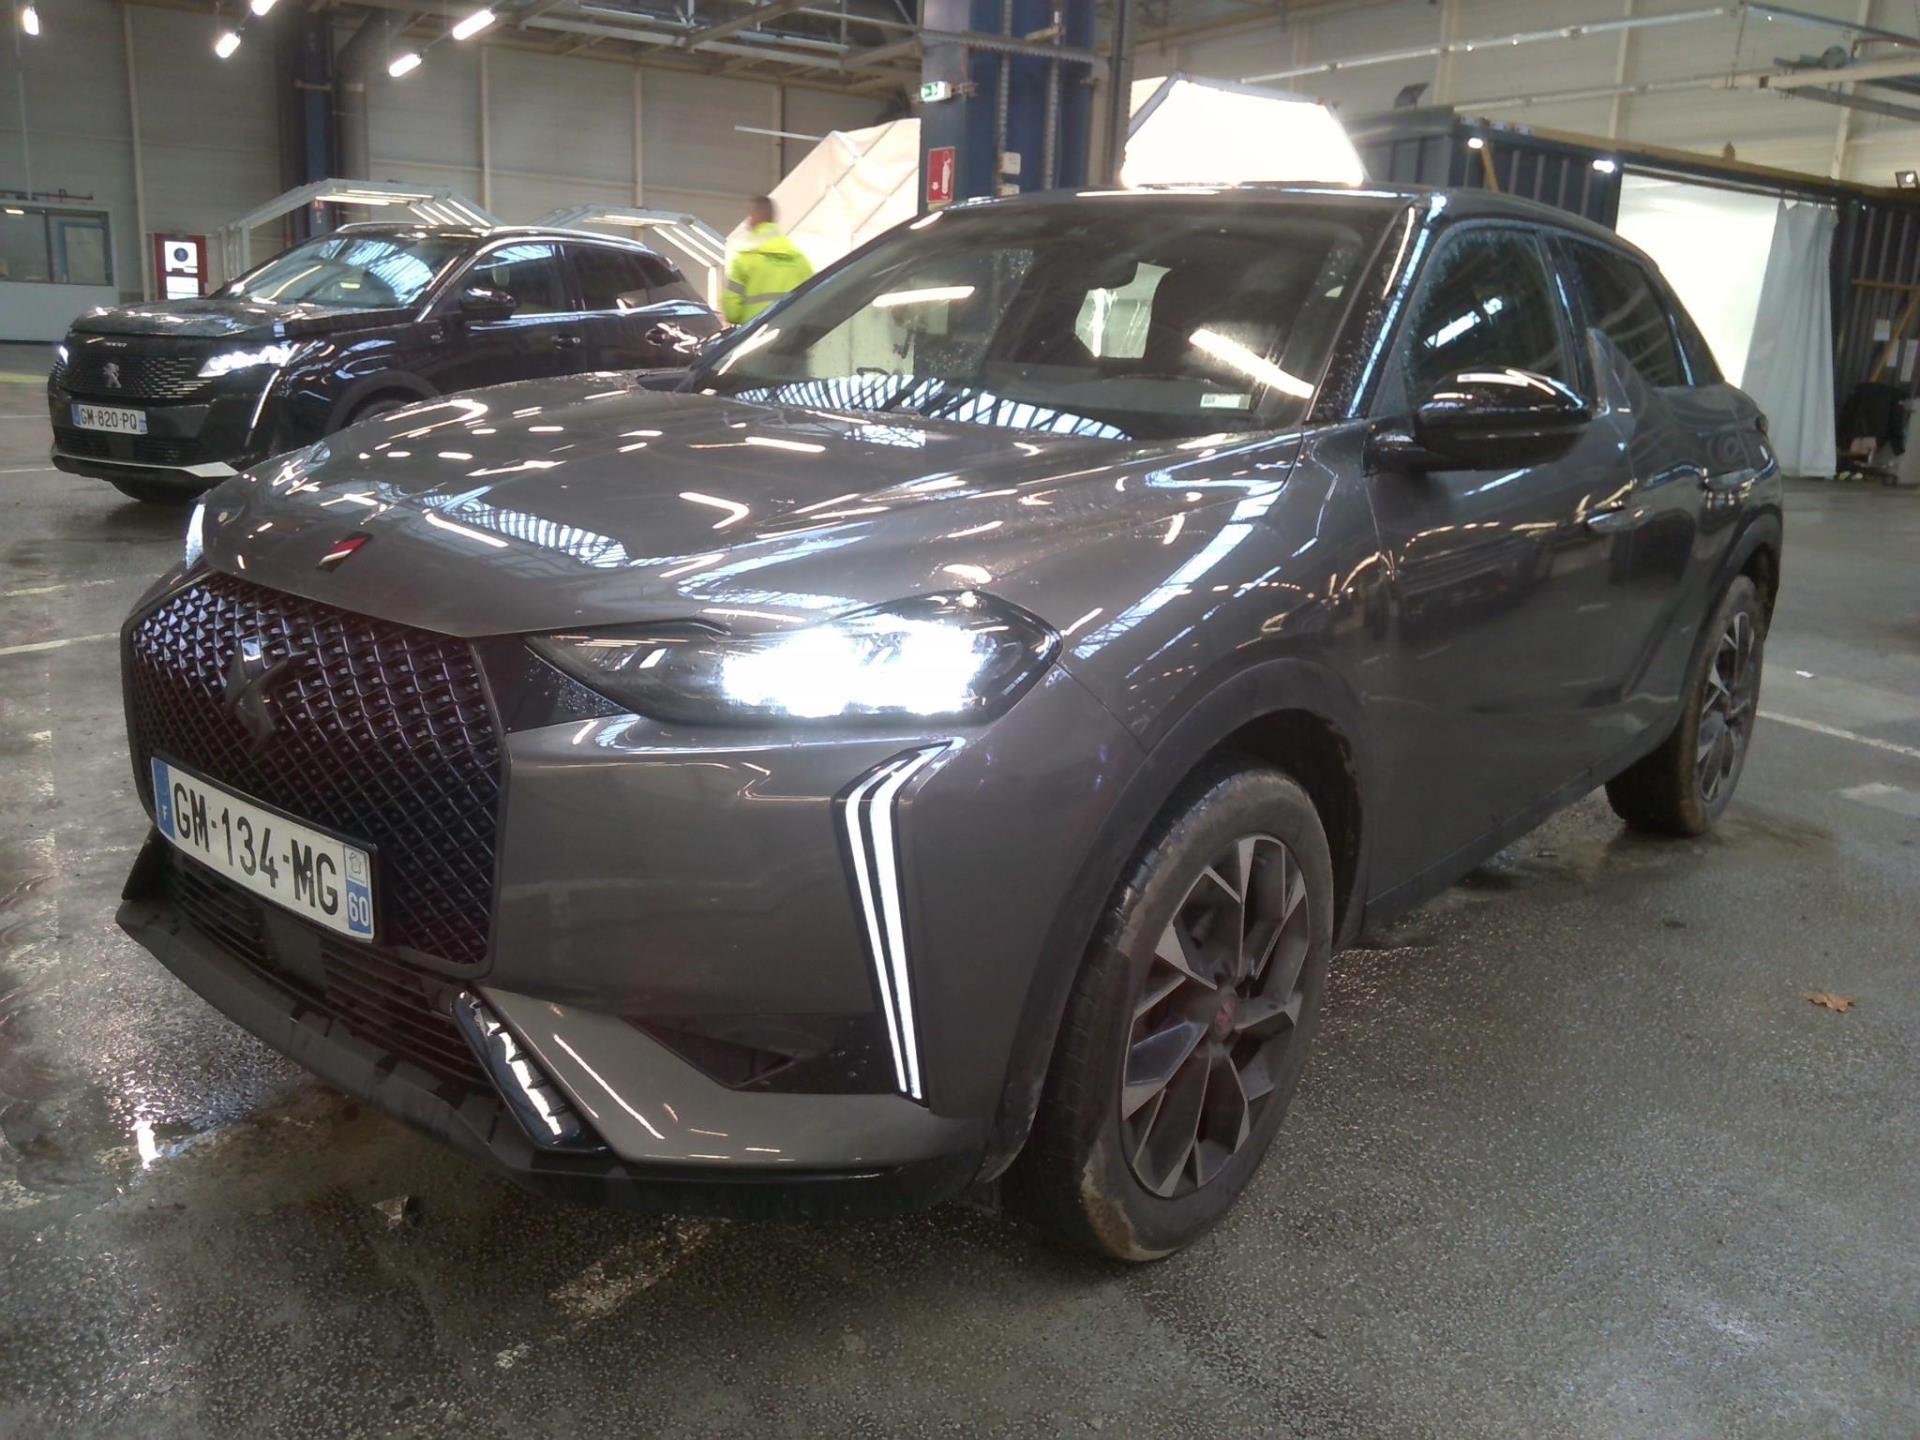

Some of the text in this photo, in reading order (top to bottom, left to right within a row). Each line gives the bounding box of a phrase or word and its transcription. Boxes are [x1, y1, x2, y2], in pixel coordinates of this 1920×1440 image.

[80, 408, 137, 430] GM-820-PQ
[162, 805, 168, 821] F
[173, 782, 339, 916] GM-134-MG
[348, 892, 370, 927] 60
